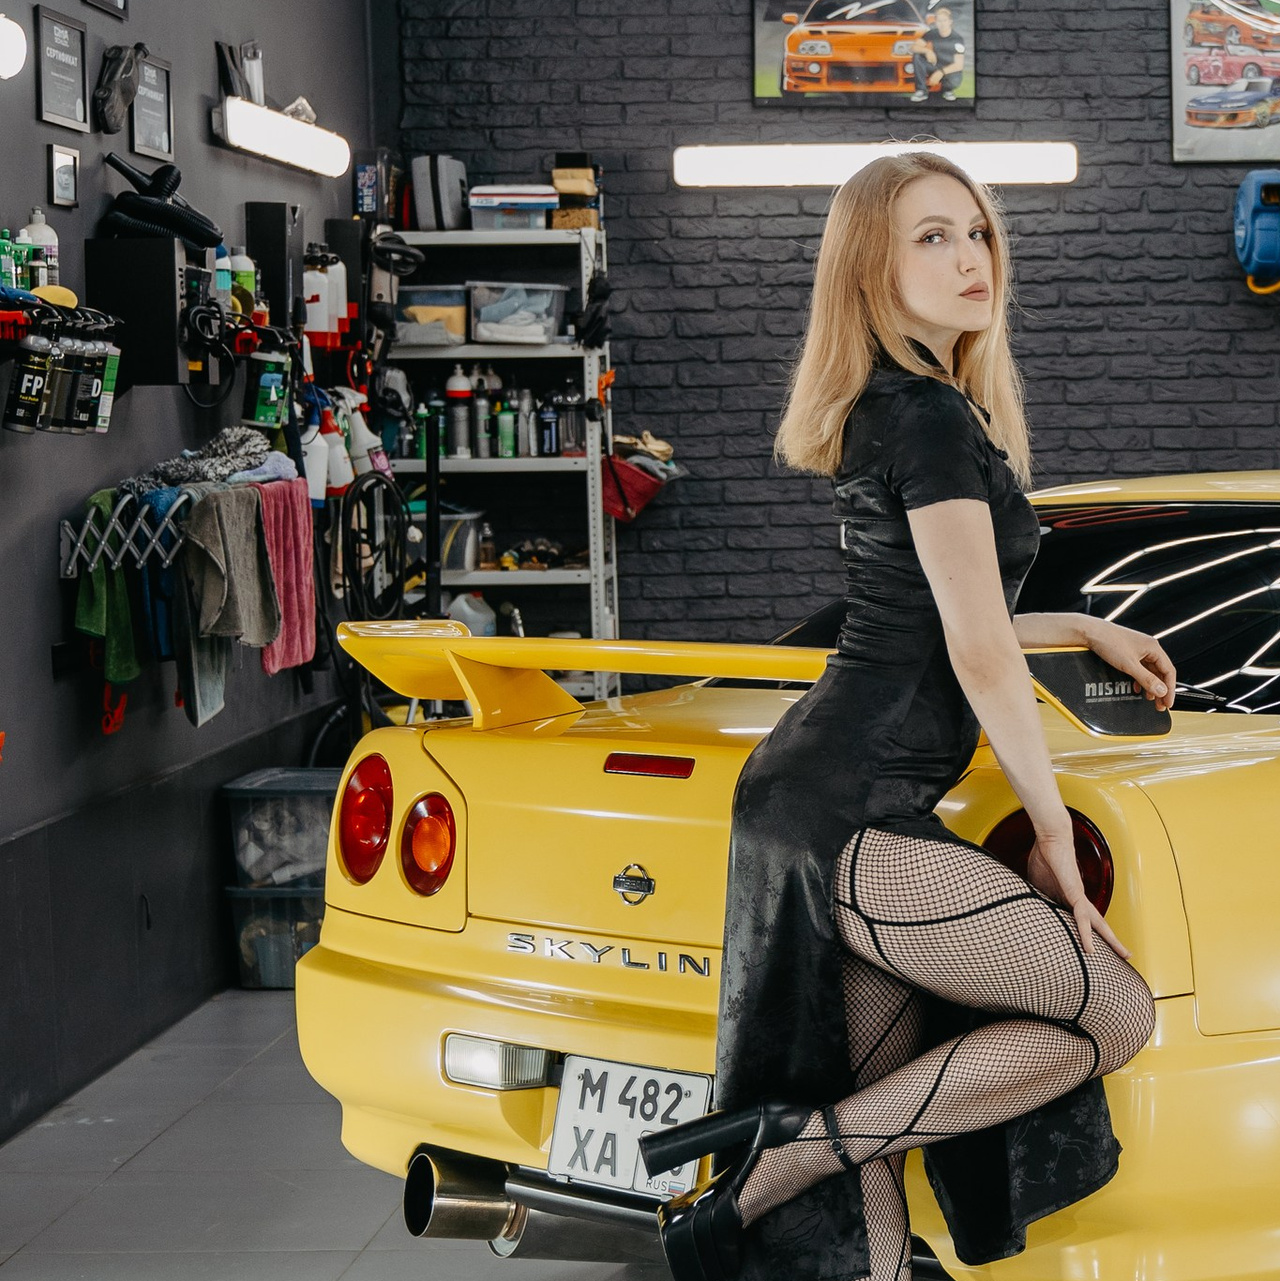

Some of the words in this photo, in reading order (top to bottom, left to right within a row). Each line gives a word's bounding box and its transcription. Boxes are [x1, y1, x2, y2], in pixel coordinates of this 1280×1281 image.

[46, 46, 78, 67] СЕРТИФИКАТ
[21, 374, 43, 396] FP
[579, 1068, 609, 1113] M
[618, 1076, 683, 1125] 482
[567, 1126, 617, 1177] XA
[646, 1179, 667, 1191] RUS
